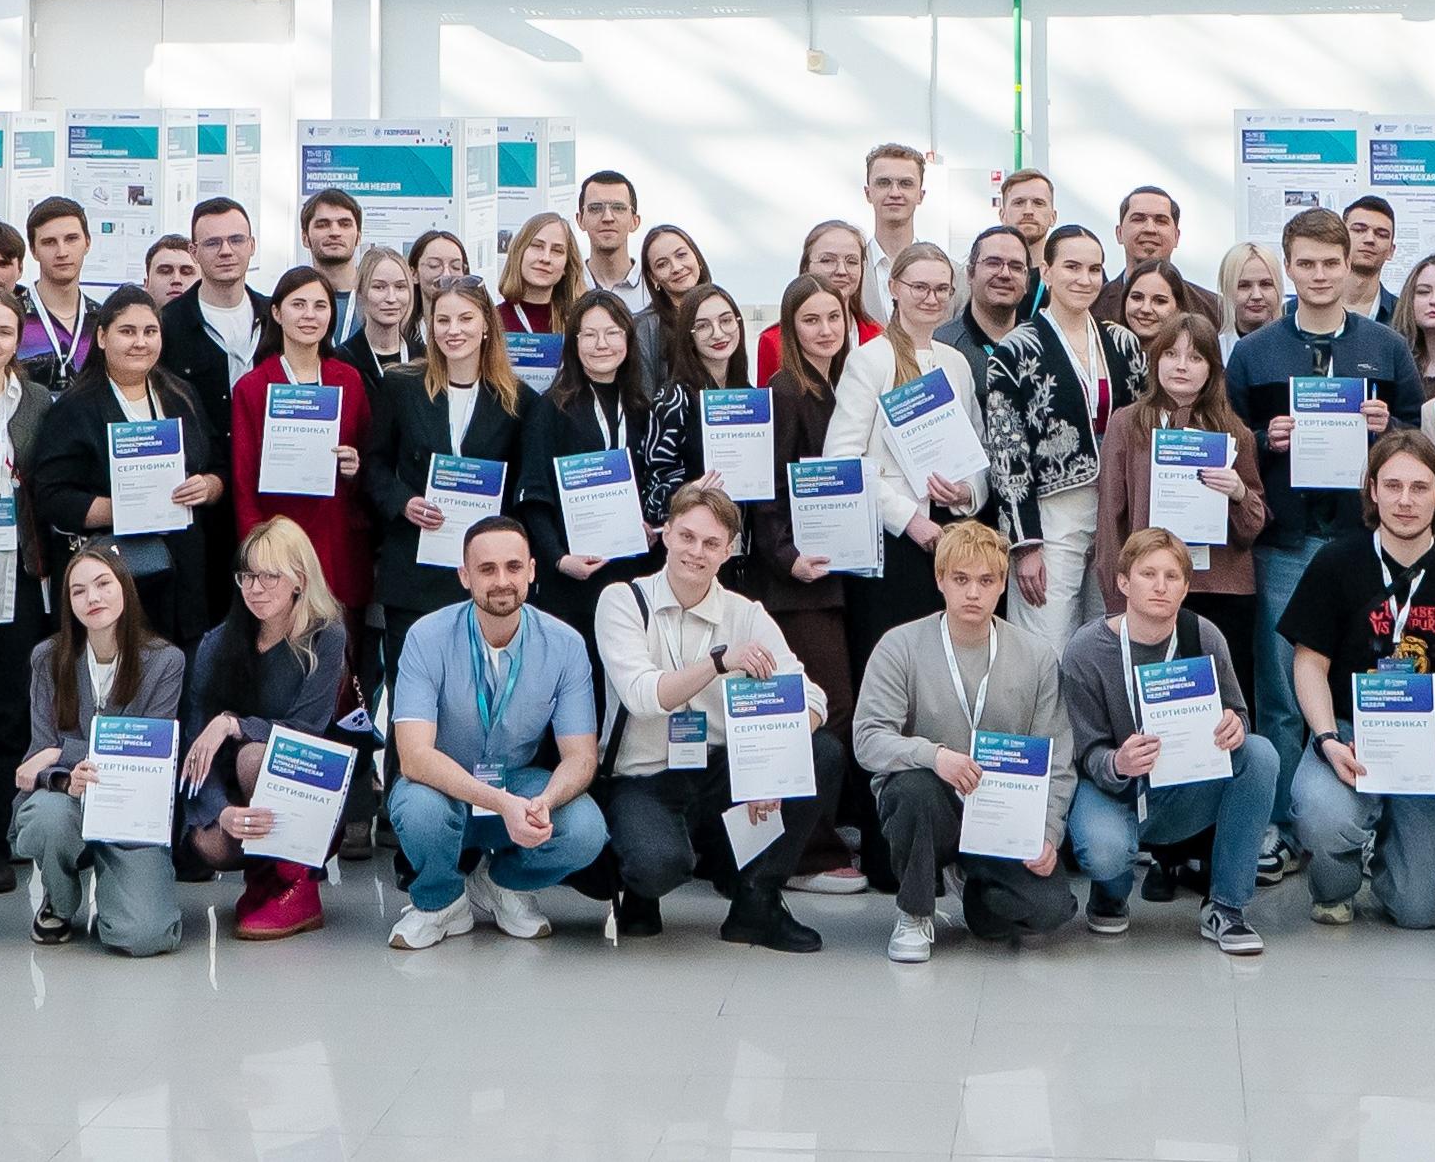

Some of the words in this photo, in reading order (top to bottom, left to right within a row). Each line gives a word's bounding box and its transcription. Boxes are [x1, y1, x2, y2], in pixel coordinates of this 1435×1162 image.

[902, 409, 955, 439] СЕРТИФИКАТ
[271, 426, 330, 434] СЕРТИФИКАТ
[117, 462, 175, 472] СЕРТИФИКАТ
[569, 489, 628, 503] СЕРТИФИКАТ
[433, 497, 492, 510] СЕРТИФИКАТ
[798, 501, 859, 511] СЕРТИФИКАТ
[1150, 704, 1212, 719] СЕРТИФИКАТ
[734, 722, 800, 733] СЕРТИФИКАТ
[1362, 720, 1427, 728] СЕРТИФИКАТ
[98, 763, 163, 773] СЕРТИФИКАТ
[978, 779, 1039, 790] ЕРТИФИКАТ
[267, 783, 330, 805] СЕРТИФИКАТ
